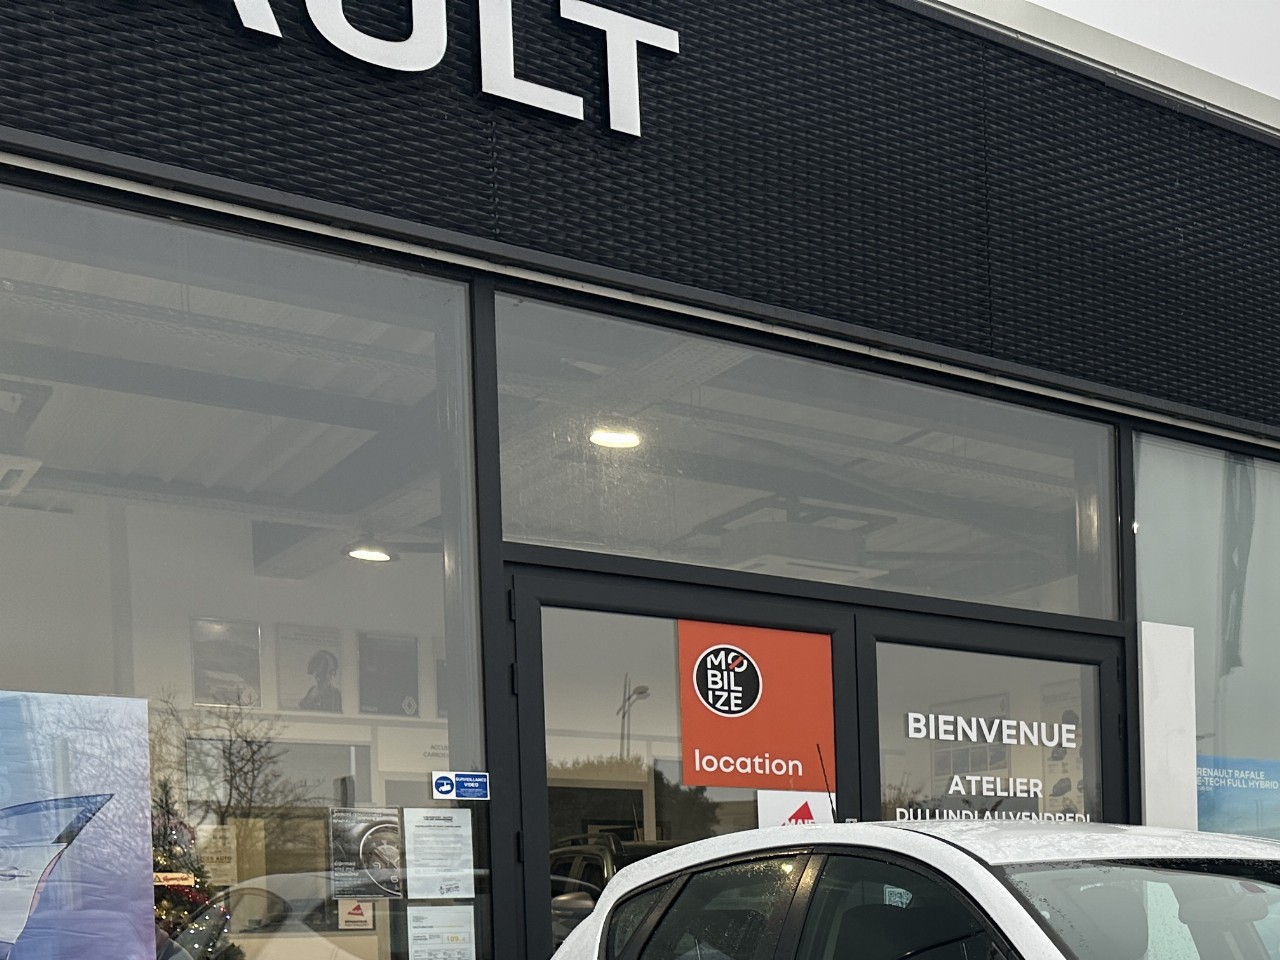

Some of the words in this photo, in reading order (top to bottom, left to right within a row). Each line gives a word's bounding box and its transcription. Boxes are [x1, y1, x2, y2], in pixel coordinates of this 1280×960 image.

[908, 712, 1076, 748] BIENVENUE
[694, 749, 803, 776] location
[1197, 767, 1233, 779] RENAULT
[1234, 770, 1265, 780] RAFALE
[948, 775, 1043, 798] ATELIER
[1227, 779, 1247, 788] FULL
[1248, 780, 1279, 789] HYBRID
